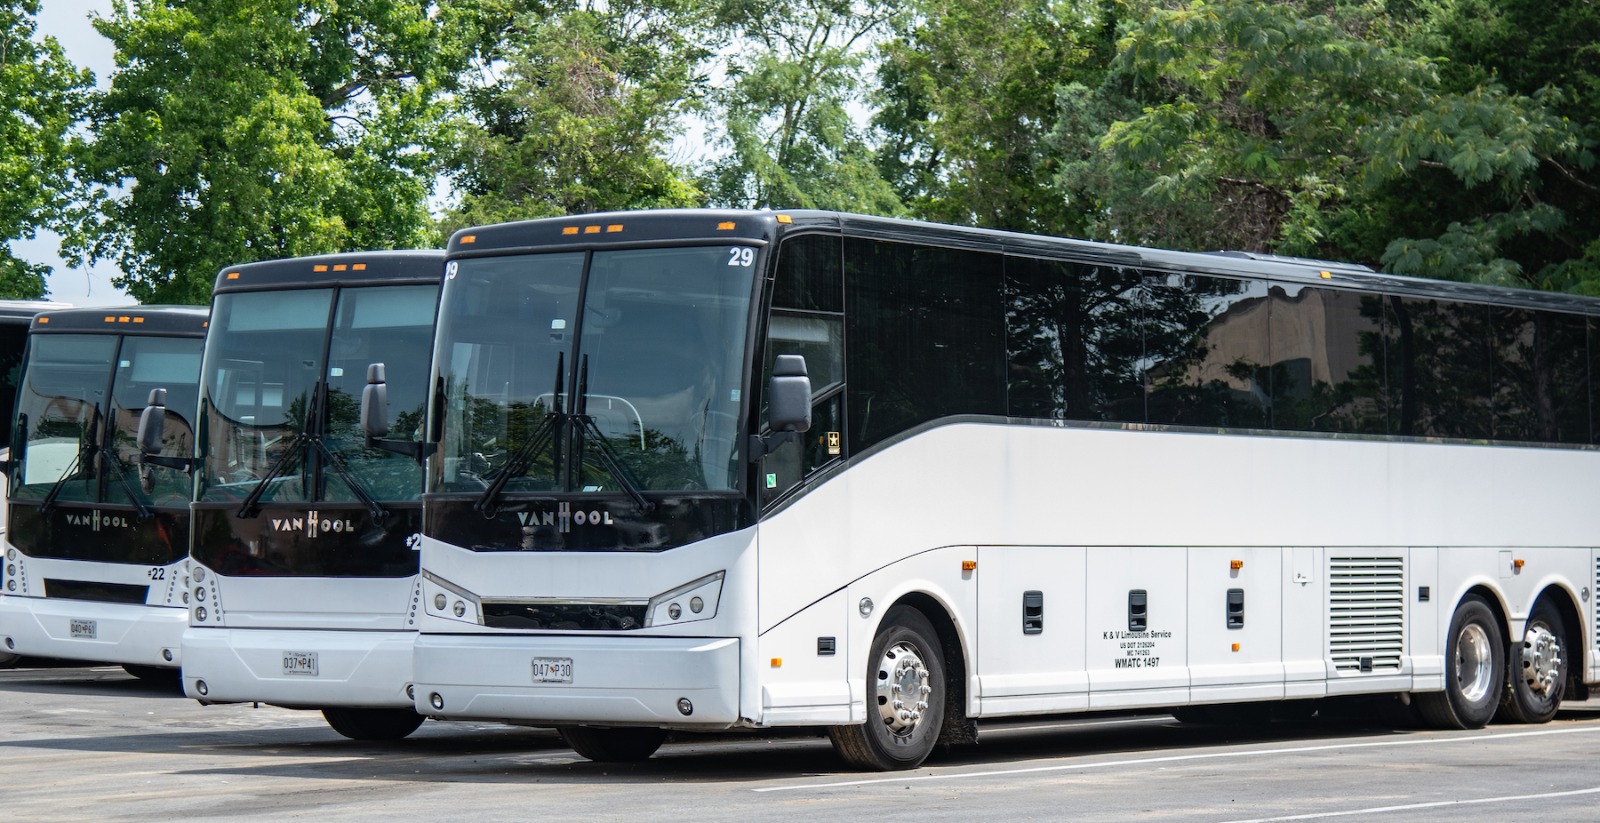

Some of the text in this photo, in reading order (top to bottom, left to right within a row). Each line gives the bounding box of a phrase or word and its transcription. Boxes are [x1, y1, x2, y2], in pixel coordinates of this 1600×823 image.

[727, 247, 754, 267] 29
[1103, 630, 1172, 640] K & V Limousine Service
[1114, 657, 1160, 669] WMATC 1497
